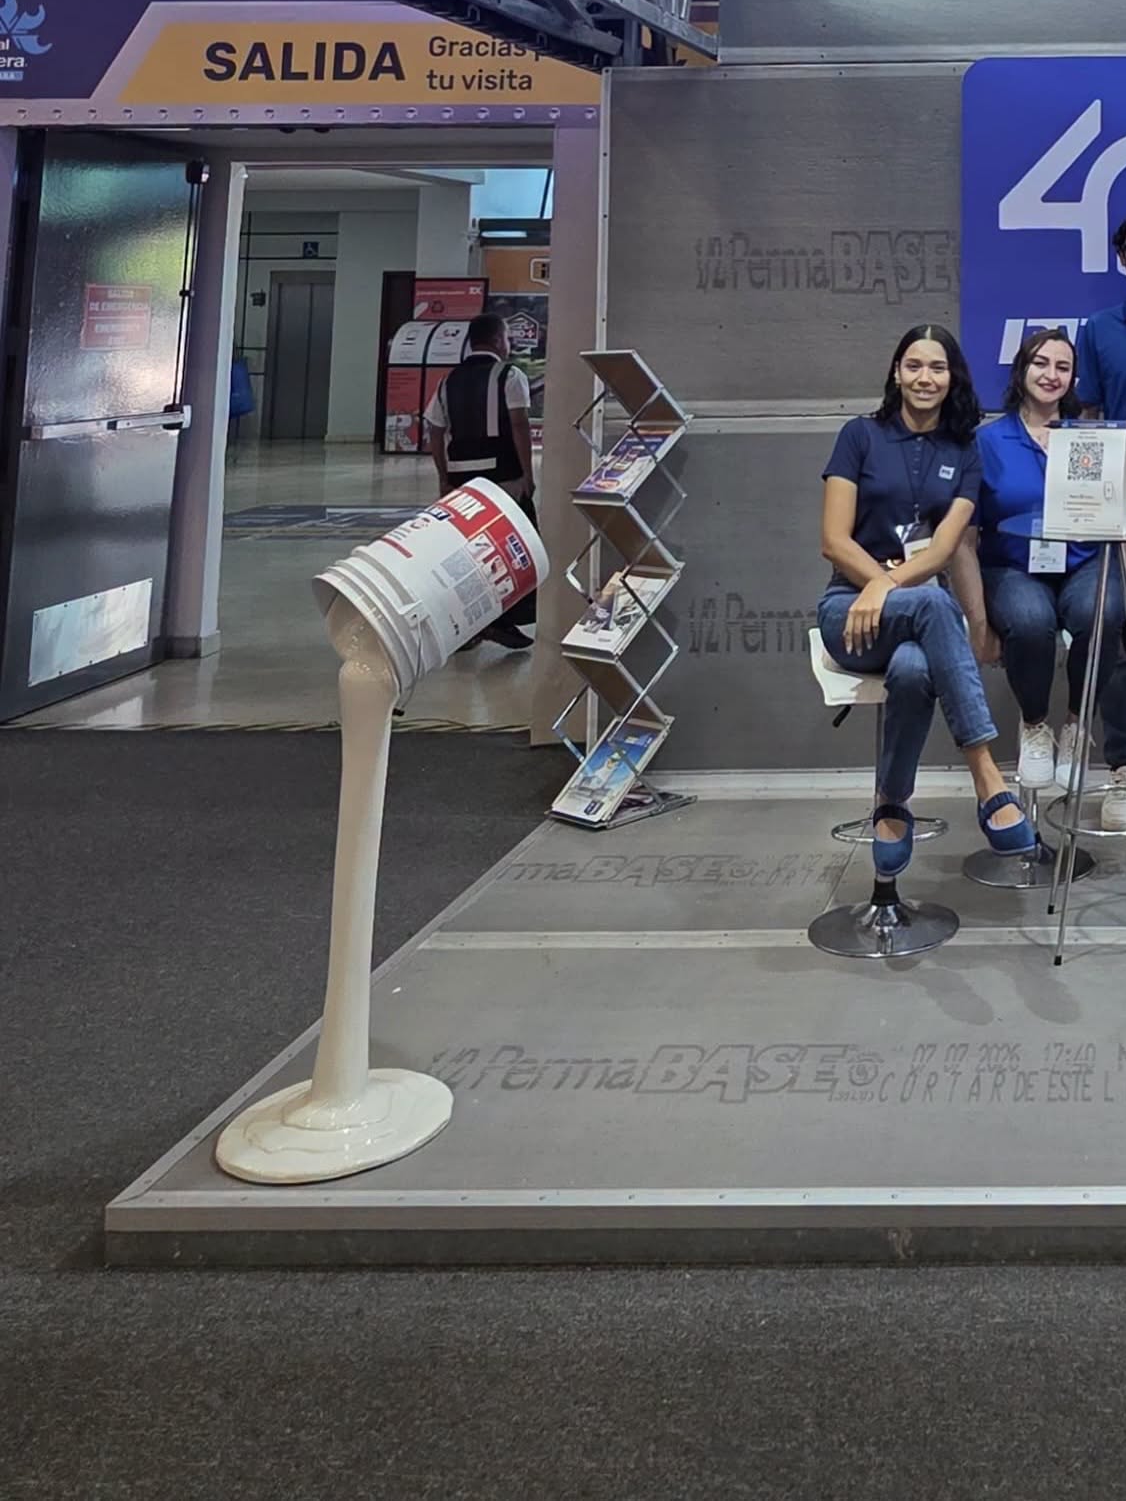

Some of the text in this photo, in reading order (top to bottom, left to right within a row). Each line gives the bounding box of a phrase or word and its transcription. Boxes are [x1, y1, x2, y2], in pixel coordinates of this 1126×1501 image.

[428, 35, 527, 57] Gracias
[203, 41, 405, 82] SALIDA
[426, 69, 533, 91] tu visita
[878, 1070, 1007, 1102] CORTAR
